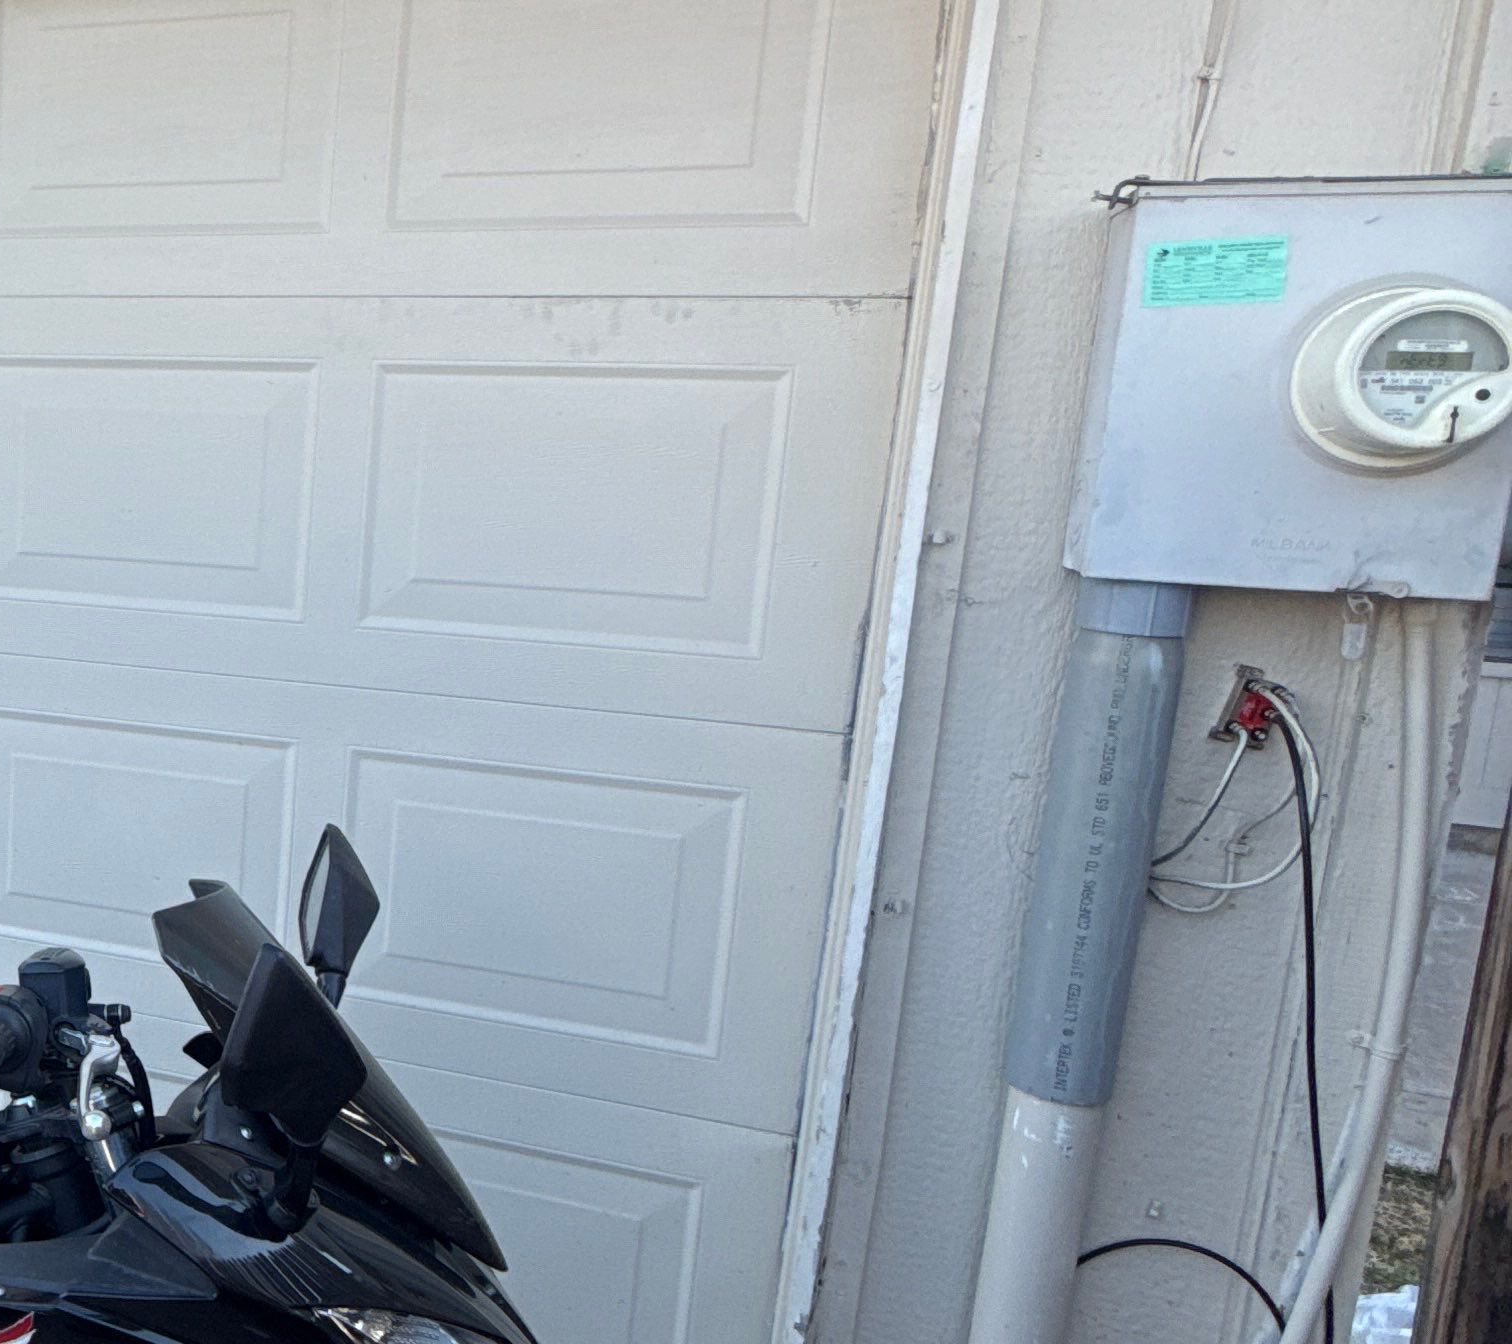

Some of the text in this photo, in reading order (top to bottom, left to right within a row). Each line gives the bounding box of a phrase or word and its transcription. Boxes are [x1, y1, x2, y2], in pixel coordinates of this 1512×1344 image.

[1095, 791, 1110, 812] 651
[1091, 815, 1107, 837] STD
[1089, 842, 1104, 856] UL
[1084, 860, 1099, 874] TO
[1076, 878, 1097, 931] CONFORMS
[1063, 983, 1081, 1023] LISTED
